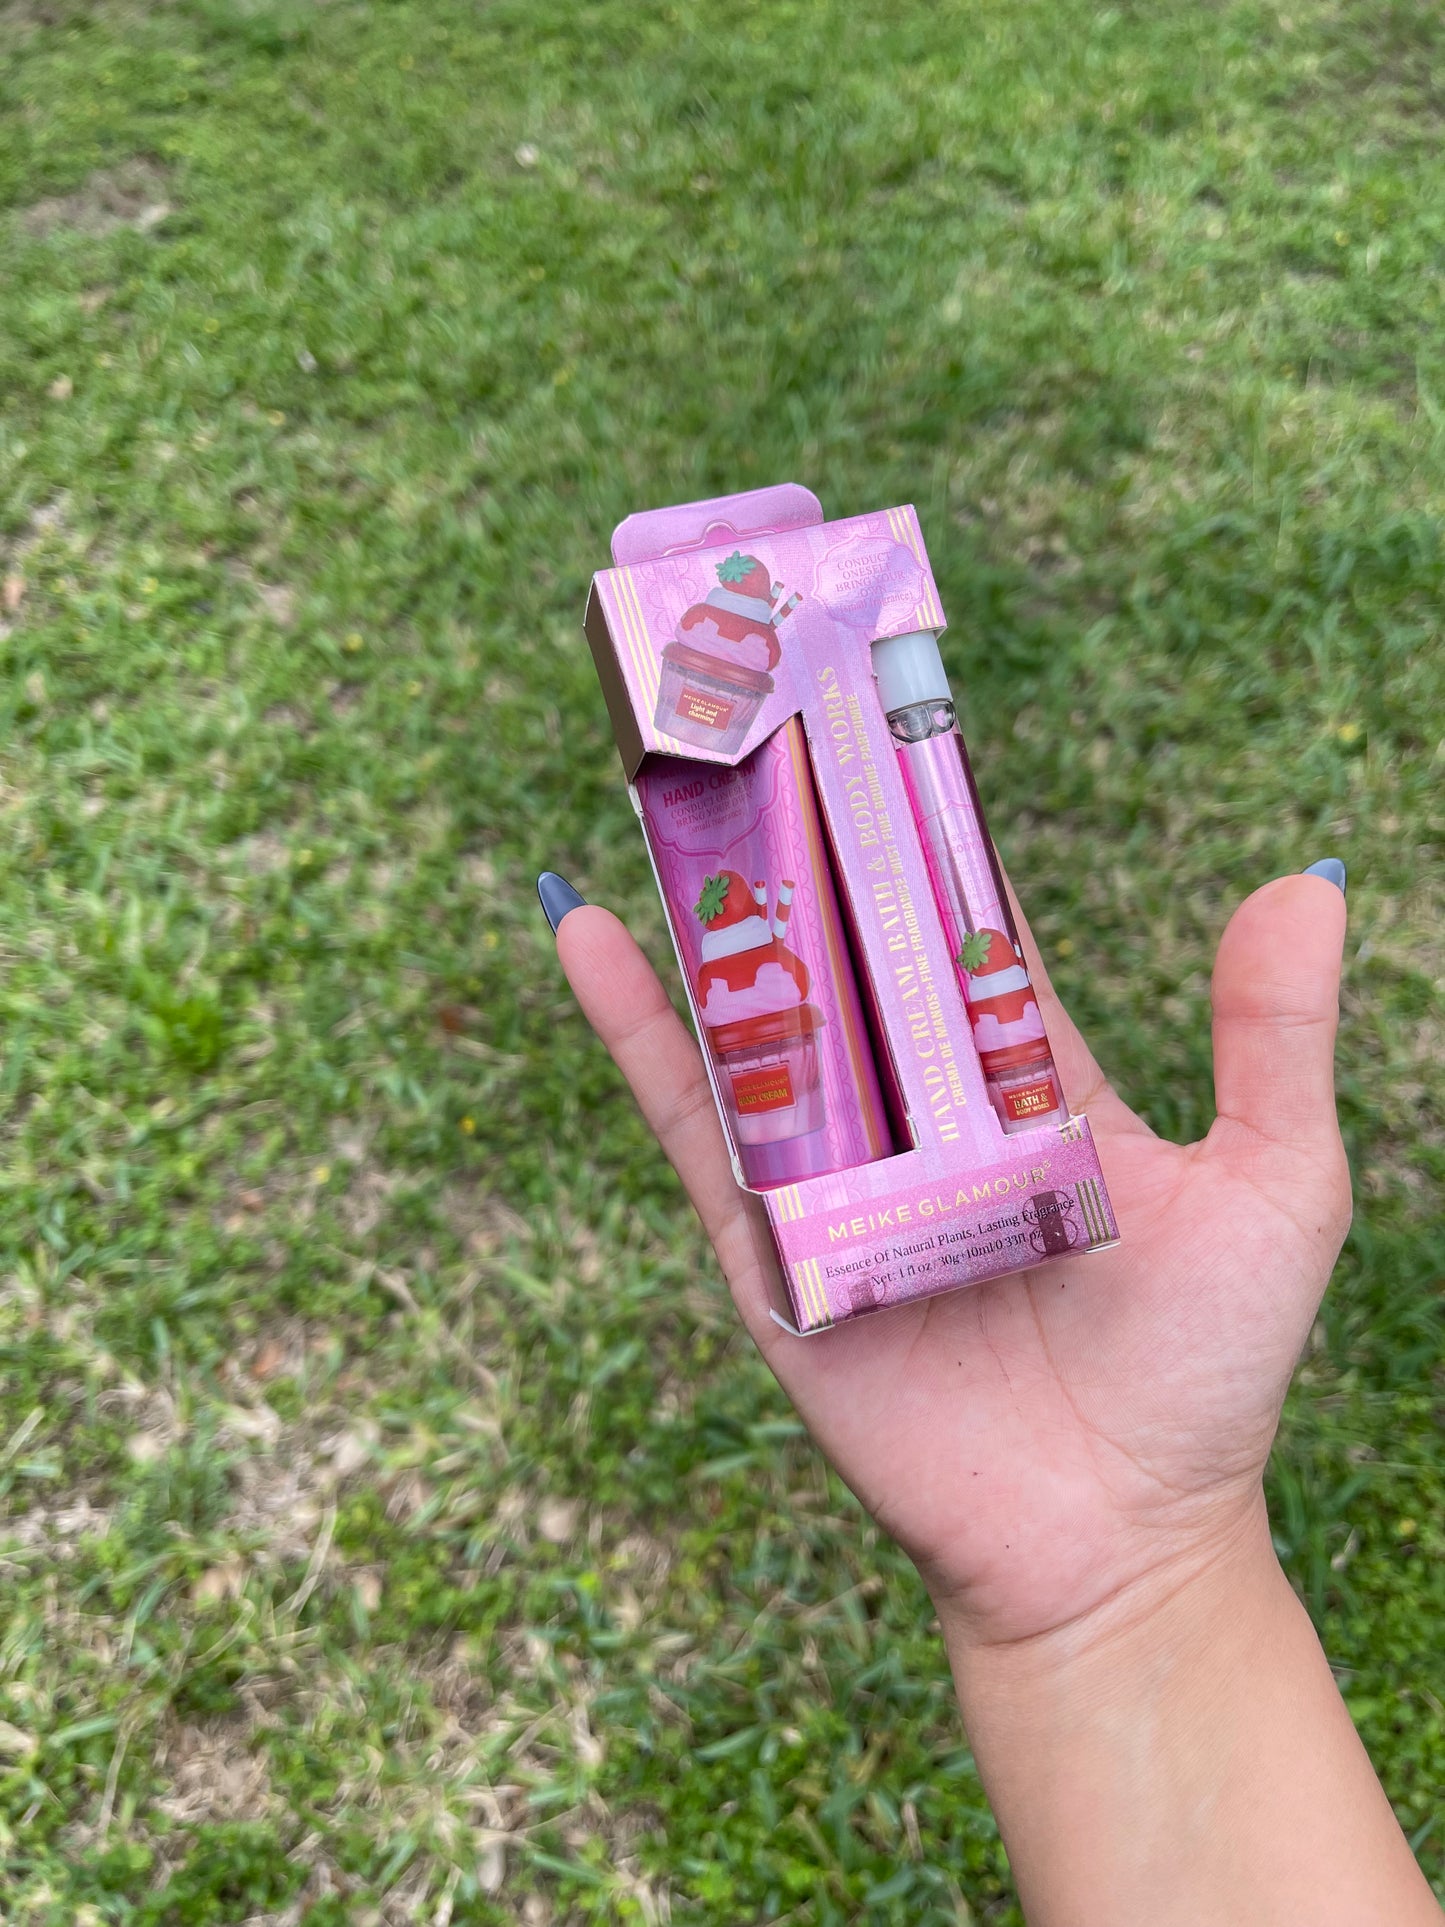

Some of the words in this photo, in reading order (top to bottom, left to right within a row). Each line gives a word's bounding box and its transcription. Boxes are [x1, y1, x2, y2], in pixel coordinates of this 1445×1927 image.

[837, 551, 890, 570] CONDUCT
[842, 562, 890, 580] ONESELF
[835, 577, 872, 592] BRING
[874, 570, 906, 584] YOUR
[688, 709, 715, 725] charming
[690, 702, 706, 714] Light
[705, 708, 718, 718] and
[818, 666, 854, 766] WORKS
[662, 780, 705, 808] HAND
[863, 764, 886, 810] BRUINE
[671, 794, 714, 819] CONDUCT
[675, 810, 705, 829] BRING
[705, 801, 731, 816] YOUR
[845, 773, 879, 848] BODY
[877, 812, 893, 841] FINE
[867, 855, 887, 874] &
[885, 844, 903, 875] MIST
[895, 878, 924, 951] FRAGRANCE
[938, 1041, 954, 1058] DE
[944, 1060, 967, 1107] CREMA
[738, 1094, 757, 1107] HAND
[759, 1088, 788, 1102] CREAM
[923, 1064, 960, 1143] HAND
[1013, 1094, 1040, 1109] BATH
[1040, 1092, 1048, 1103] &
[1016, 1107, 1031, 1116] BODY
[1032, 1102, 1050, 1112] WORKS
[827, 1203, 913, 1243] MEIKE
[825, 1257, 872, 1279] Essence
[874, 1249, 891, 1265] Of
[893, 1236, 936, 1260] Natural
[937, 1228, 977, 1247] Plants,
[977, 1215, 1021, 1236] Lasting
[1021, 1198, 1075, 1223] Fragrance
[871, 1271, 898, 1286] Net:
[899, 1267, 904, 1279] 1
[907, 1264, 917, 1278] fl
